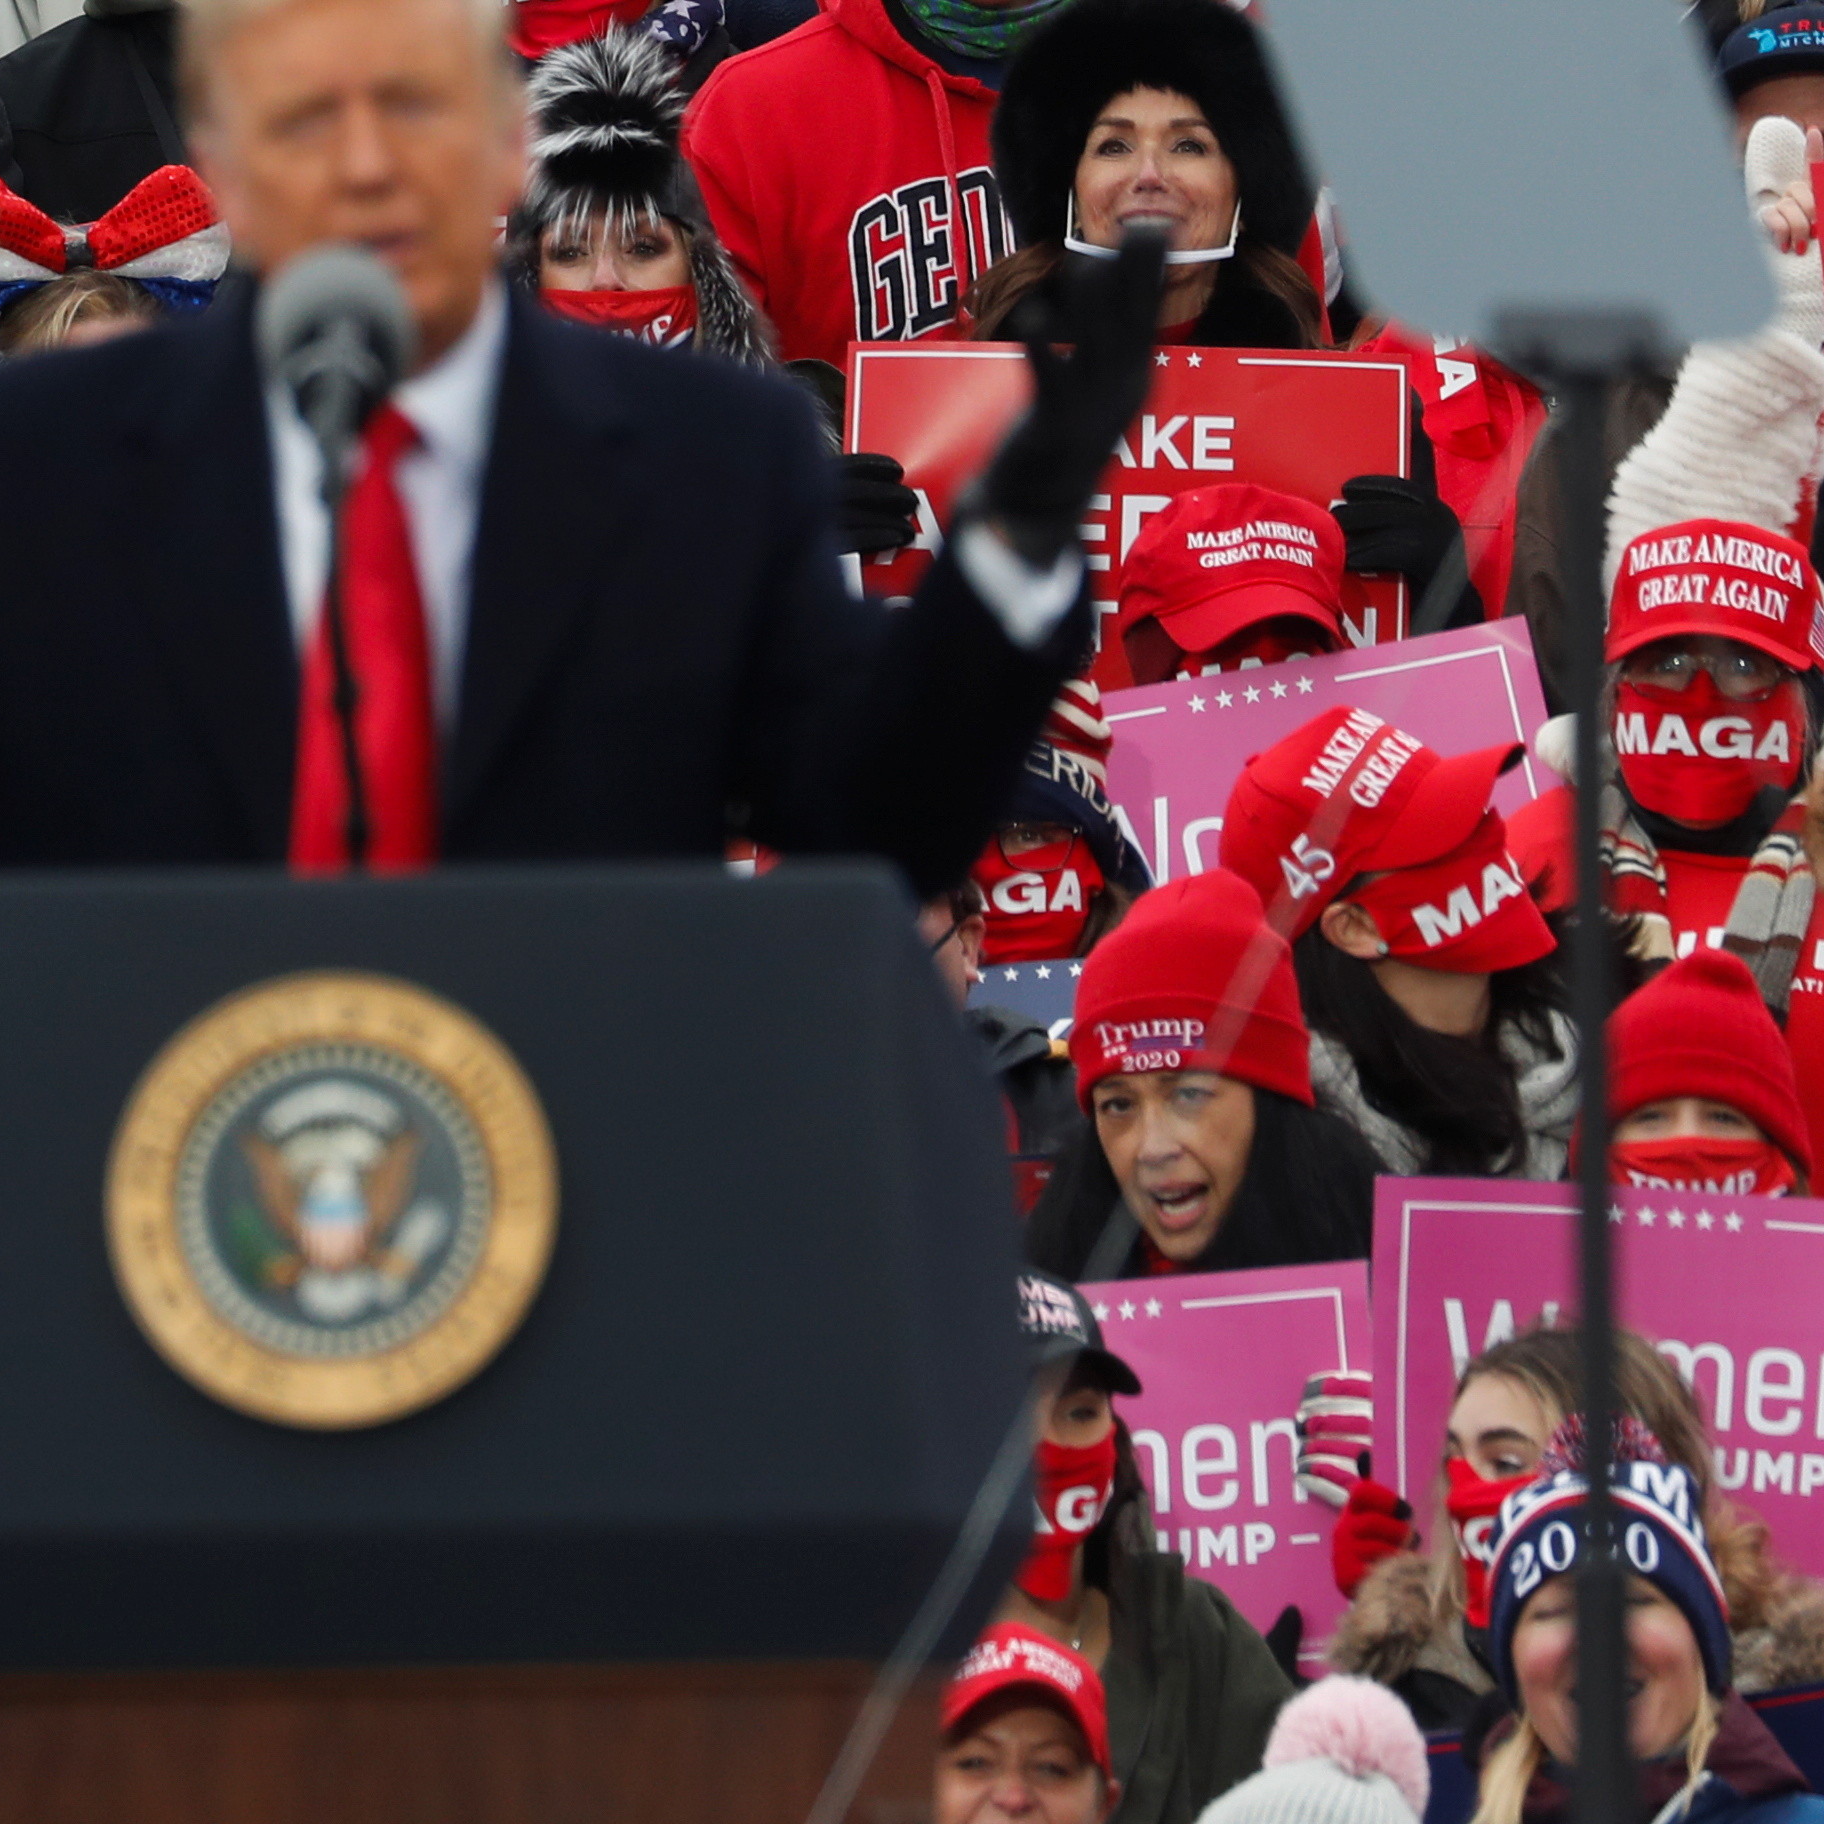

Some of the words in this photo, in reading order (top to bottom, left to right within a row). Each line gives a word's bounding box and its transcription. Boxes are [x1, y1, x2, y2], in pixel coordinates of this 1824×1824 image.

[1187, 527, 1239, 549] MAKE
[1240, 520, 1317, 547] AMERICA
[1200, 546, 1254, 568] GREAT
[1255, 542, 1313, 566] AGAIN
[1630, 538, 1691, 575] MAKE
[1694, 531, 1803, 584] AMERICA
[1637, 579, 1703, 612] GREAT
[1706, 575, 1788, 623] AGAIN
[1617, 713, 1789, 764] MAGA
[1280, 834, 1338, 901] 45
[1095, 1018, 1204, 1051] Trump
[1121, 1050, 1180, 1073] 2020
